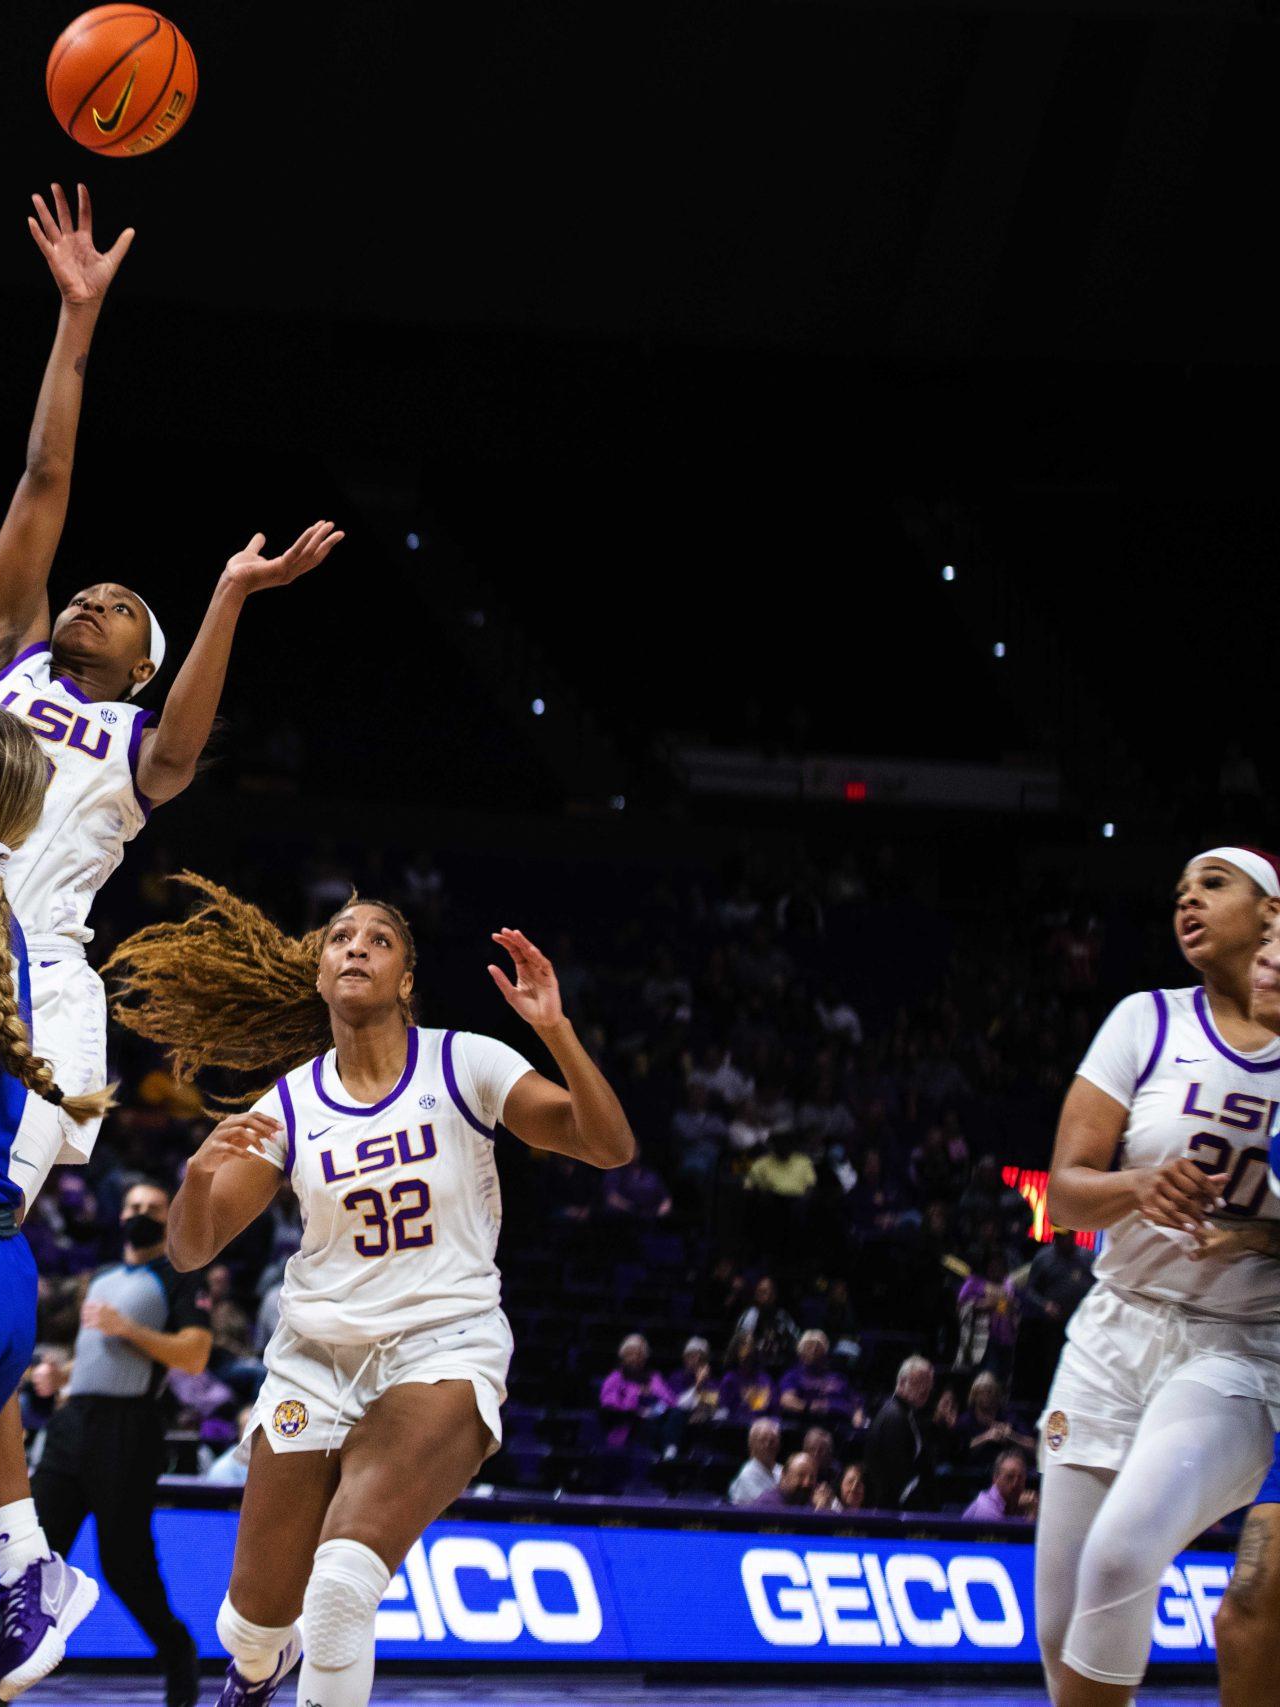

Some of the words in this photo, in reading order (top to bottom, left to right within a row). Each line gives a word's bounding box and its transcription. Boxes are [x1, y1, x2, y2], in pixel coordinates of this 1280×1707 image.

[319, 1122, 438, 1185] LSU
[342, 1177, 434, 1259] 32
[741, 1548, 1024, 1648] GEICO
